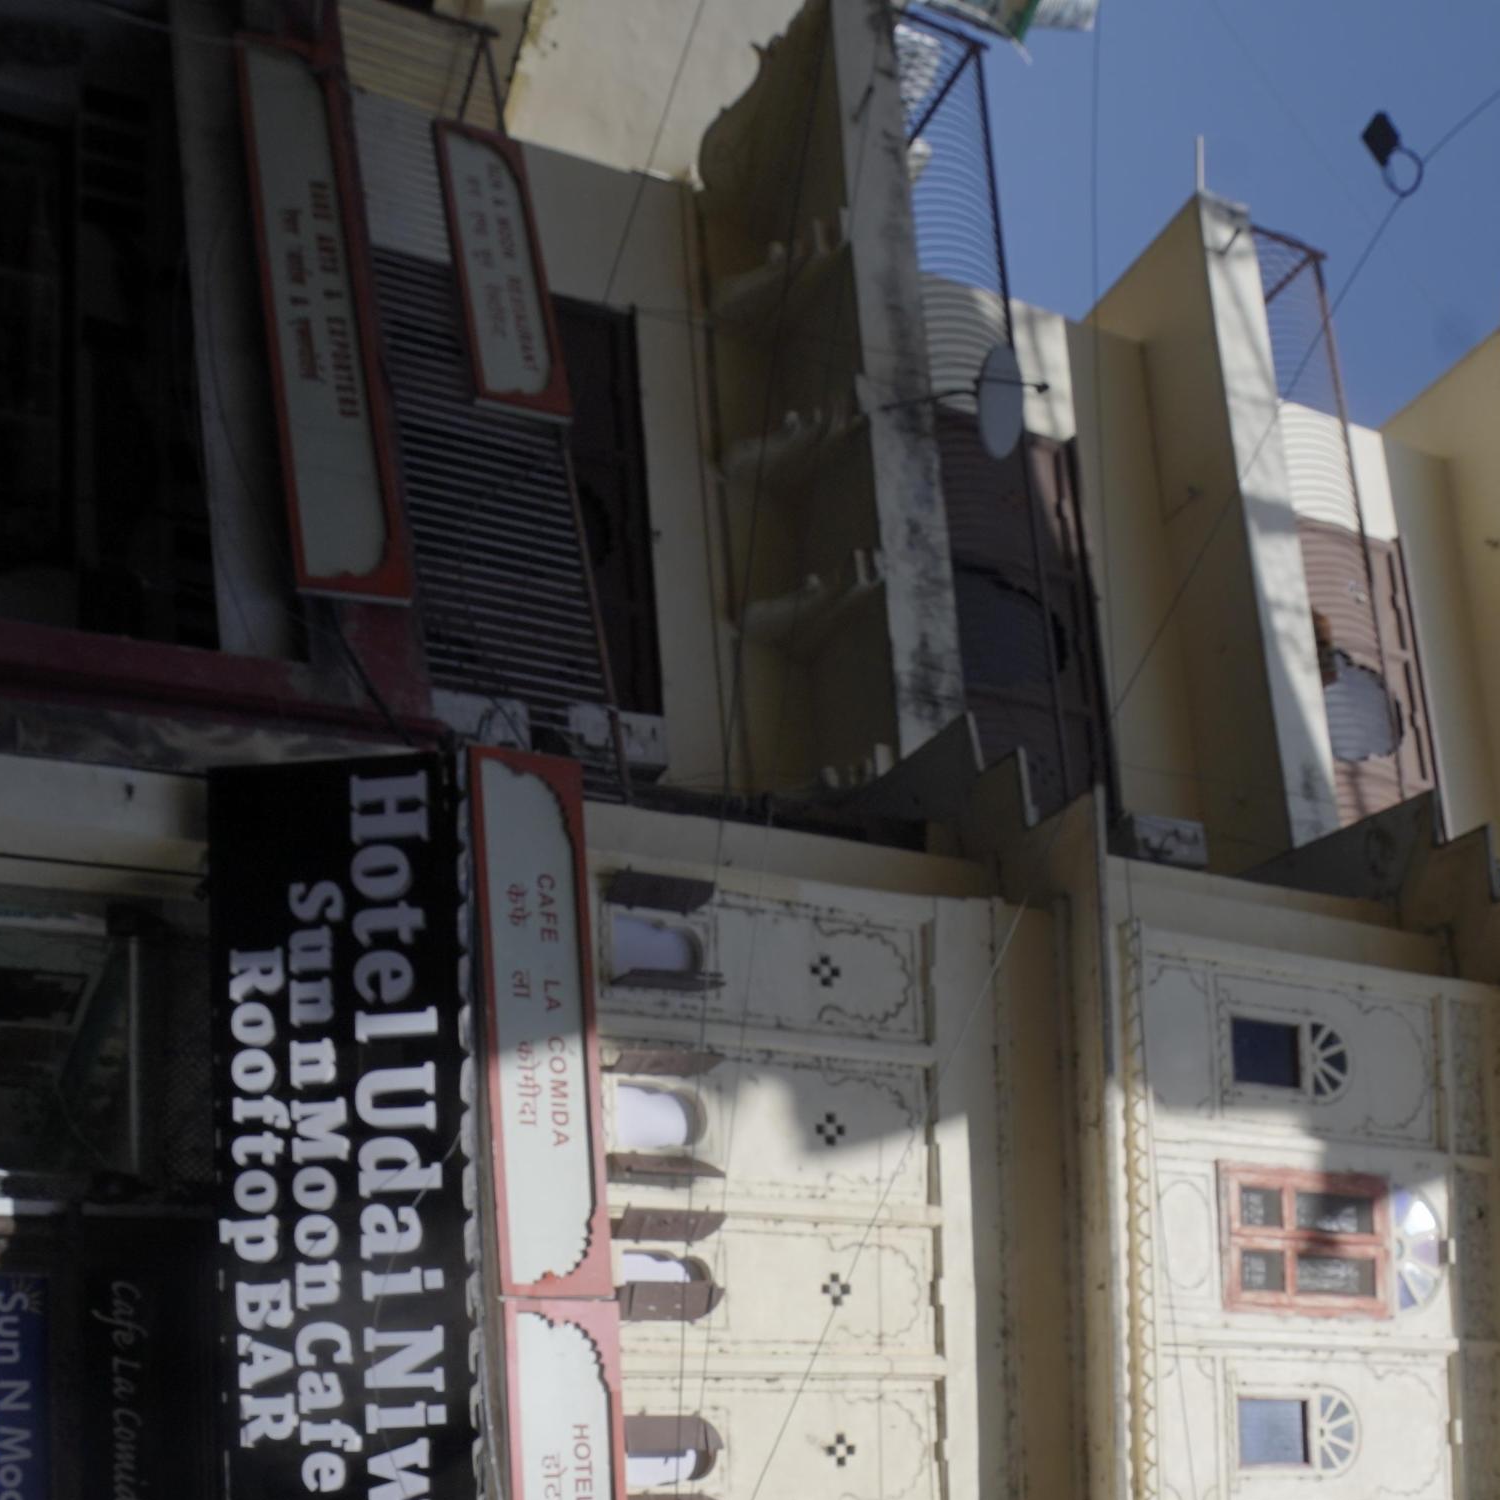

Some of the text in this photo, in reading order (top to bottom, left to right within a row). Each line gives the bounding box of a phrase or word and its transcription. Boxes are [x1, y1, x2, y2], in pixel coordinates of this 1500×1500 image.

[350, 770, 439, 1043] Hotel
[511, 970, 531, 999] ला
[537, 874, 570, 1147] CAFE LA COMIDA
[219, 946, 299, 1448] Rooftop BAR
[287, 880, 363, 1493] Sun n Moon Cafe
[355, 1060, 445, 1301] Udai
[90, 1280, 149, 1348] Cafe
[112, 1356, 142, 1400] La
